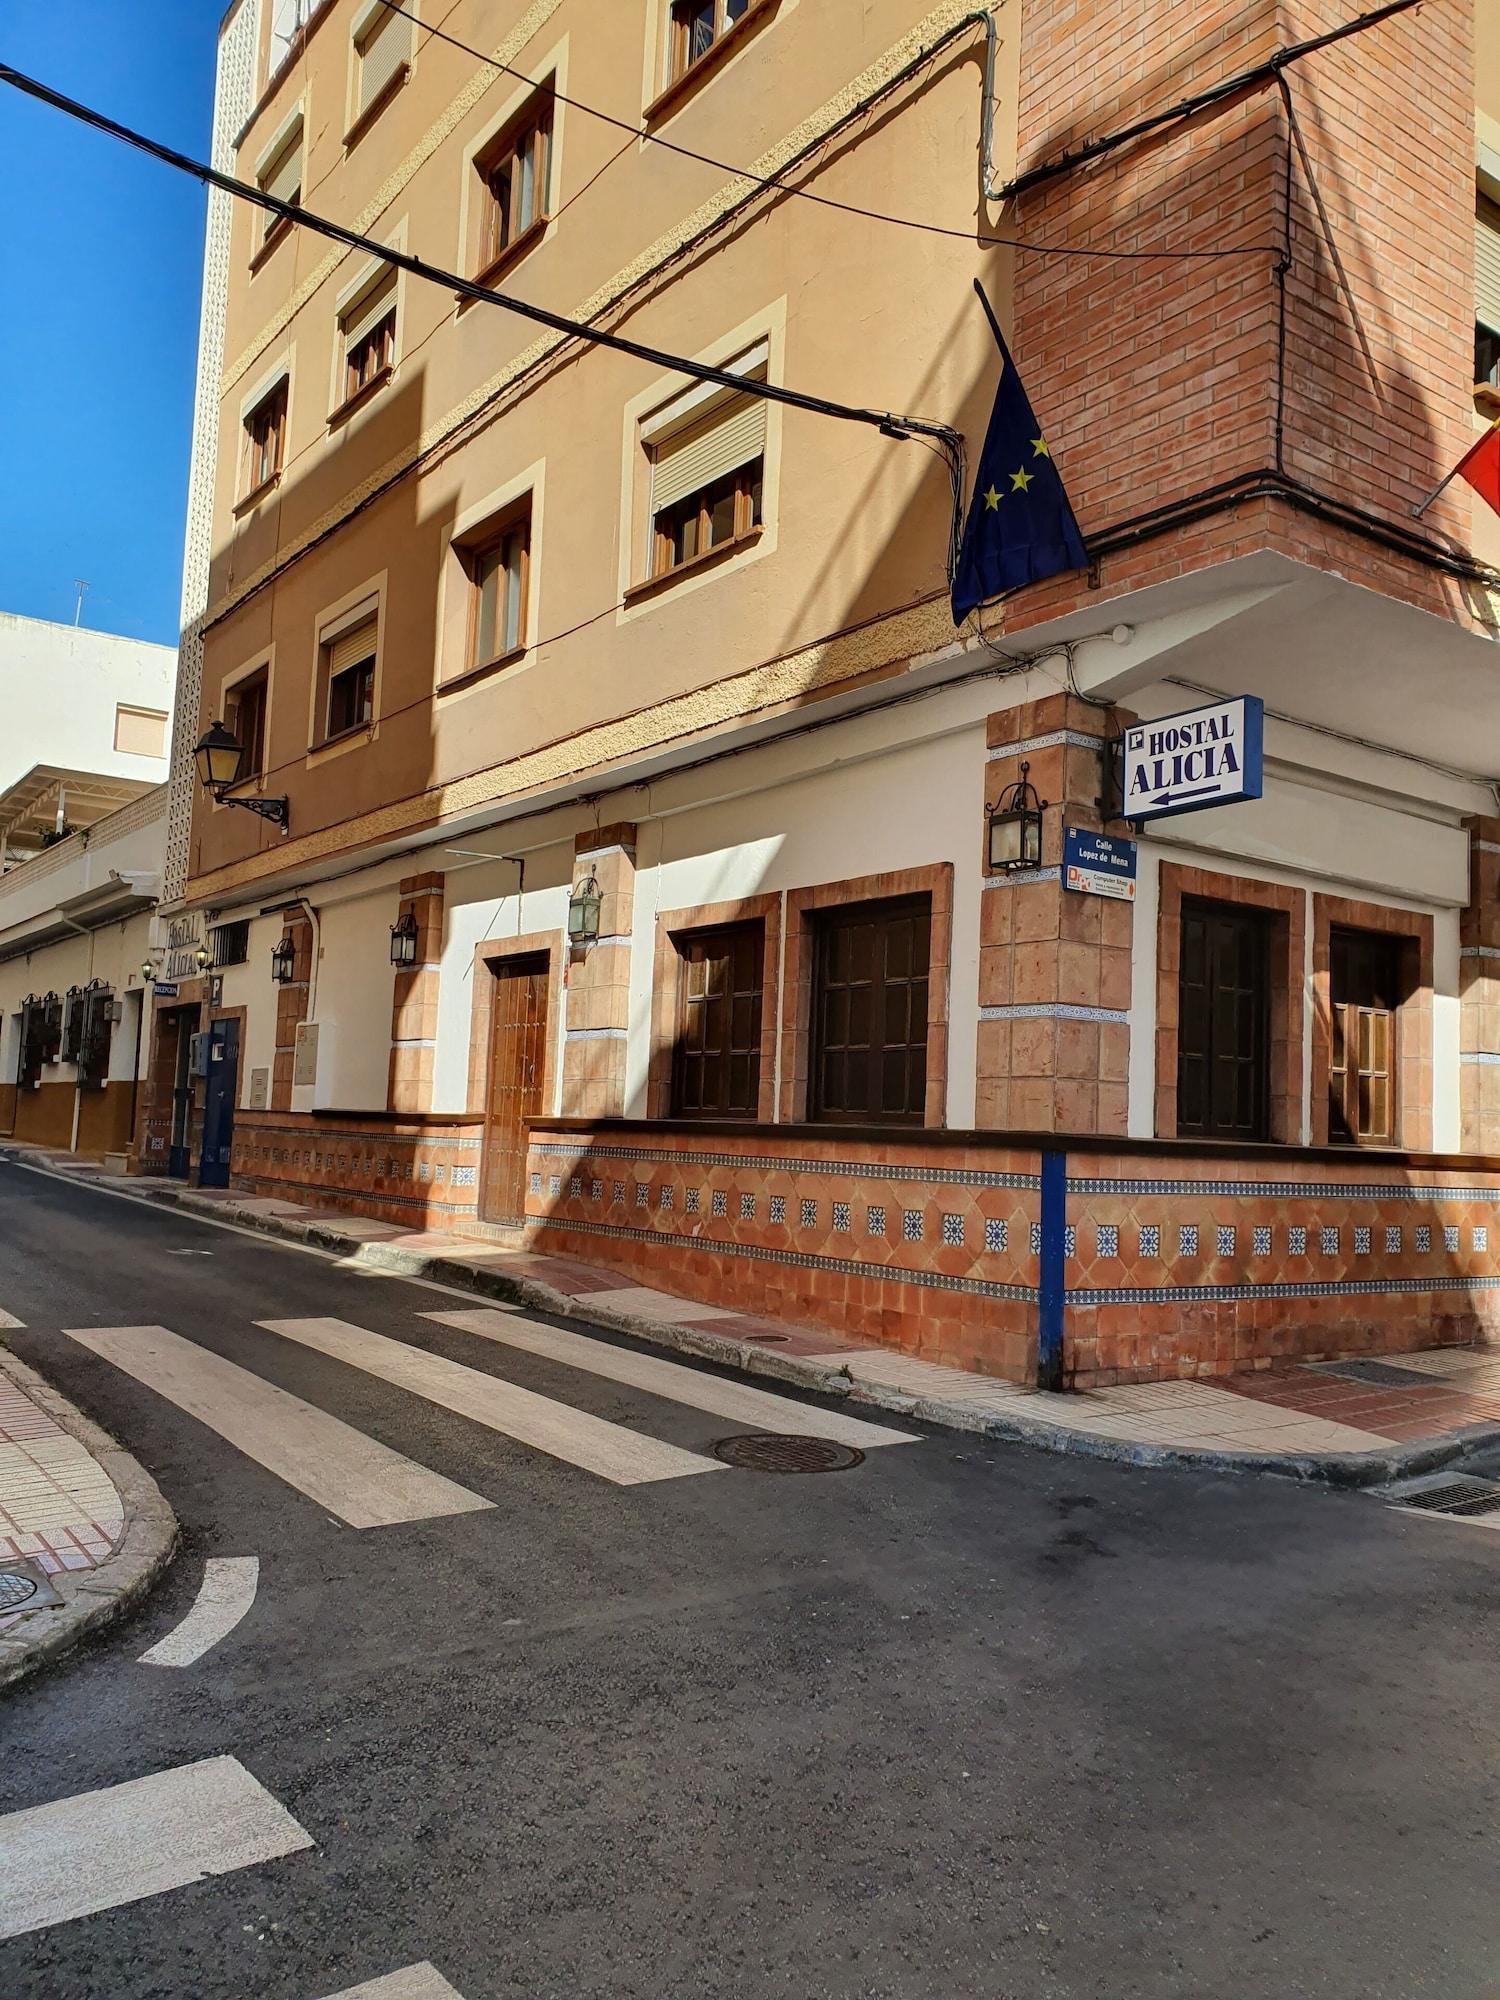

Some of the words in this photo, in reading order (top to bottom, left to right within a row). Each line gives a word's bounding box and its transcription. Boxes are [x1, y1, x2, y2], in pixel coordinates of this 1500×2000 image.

[1149, 714, 1235, 757] HOSTAL
[1129, 742, 1240, 796] ALICIA
[1079, 847, 1099, 860] Lopez
[1099, 852, 1108, 863] de
[1110, 854, 1129, 867] Mena
[1095, 839, 1113, 851] Calle
[1093, 874, 1116, 884] Computer
[168, 915, 200, 950] HOSTAL
[166, 951, 198, 979] ALICIA
[213, 979, 220, 998] P
